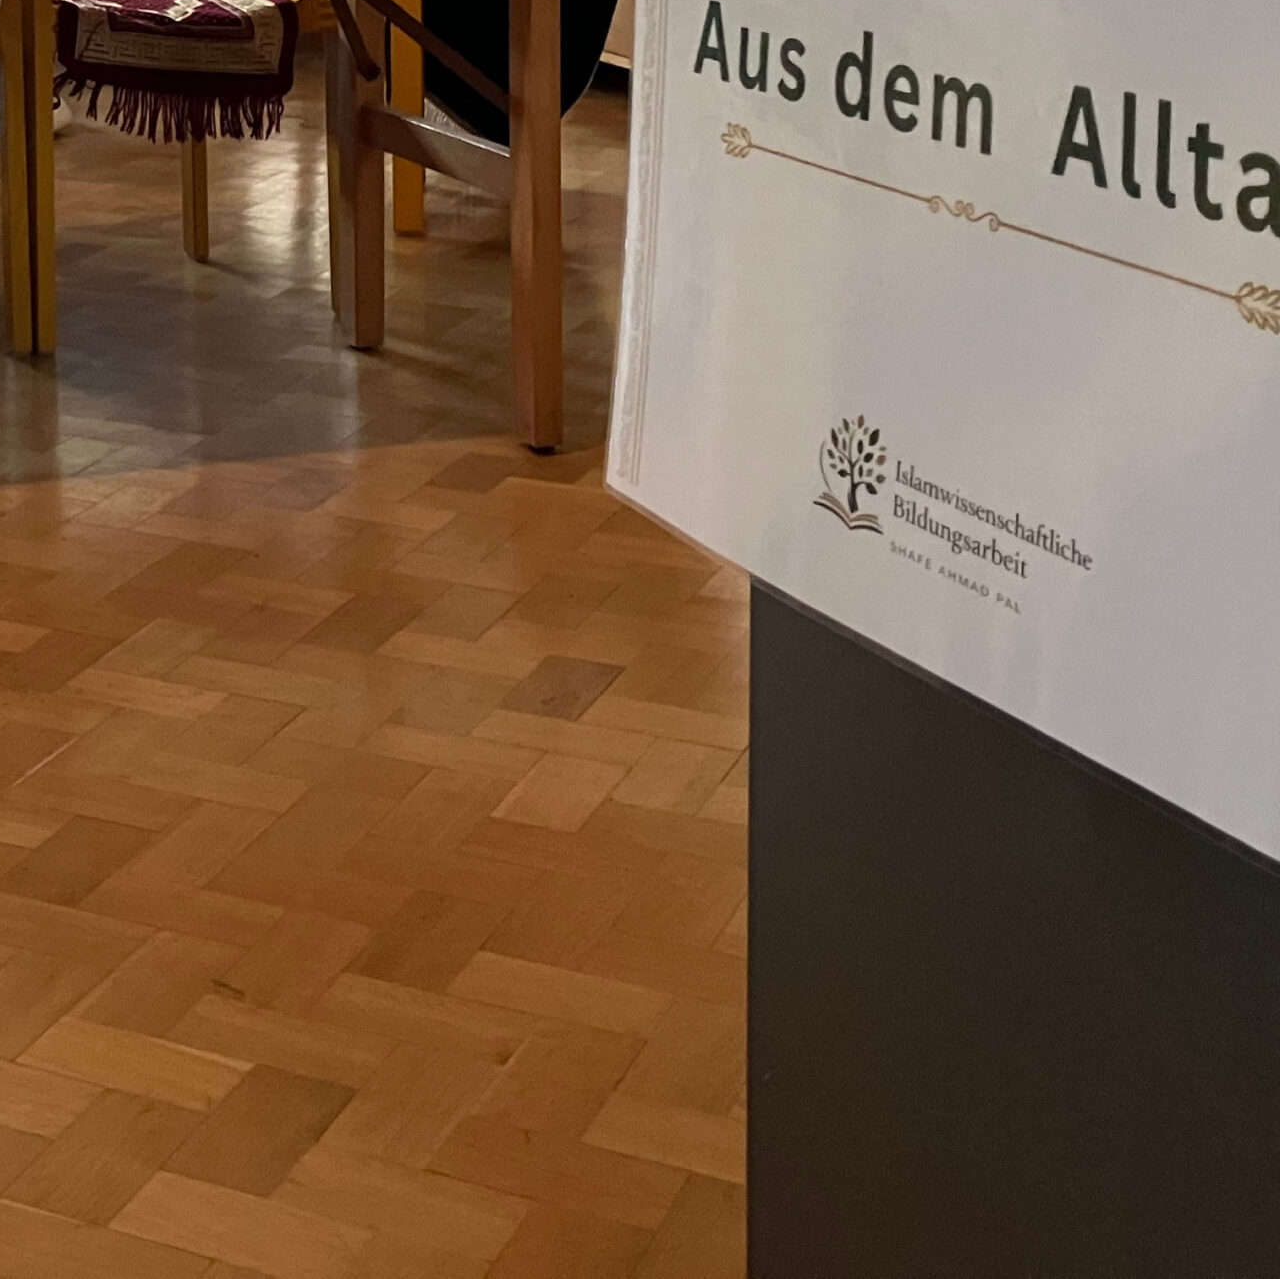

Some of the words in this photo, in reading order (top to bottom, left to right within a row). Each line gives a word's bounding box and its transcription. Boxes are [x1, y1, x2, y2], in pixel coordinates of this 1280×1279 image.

[694, 0, 806, 102] Aus
[835, 31, 993, 155] dem
[1051, 85, 1280, 238] Allta
[893, 494, 1028, 579] Bildungsarbeit
[895, 460, 1093, 570] Islamwissenschaftliche
[938, 565, 990, 597] AHMAD
